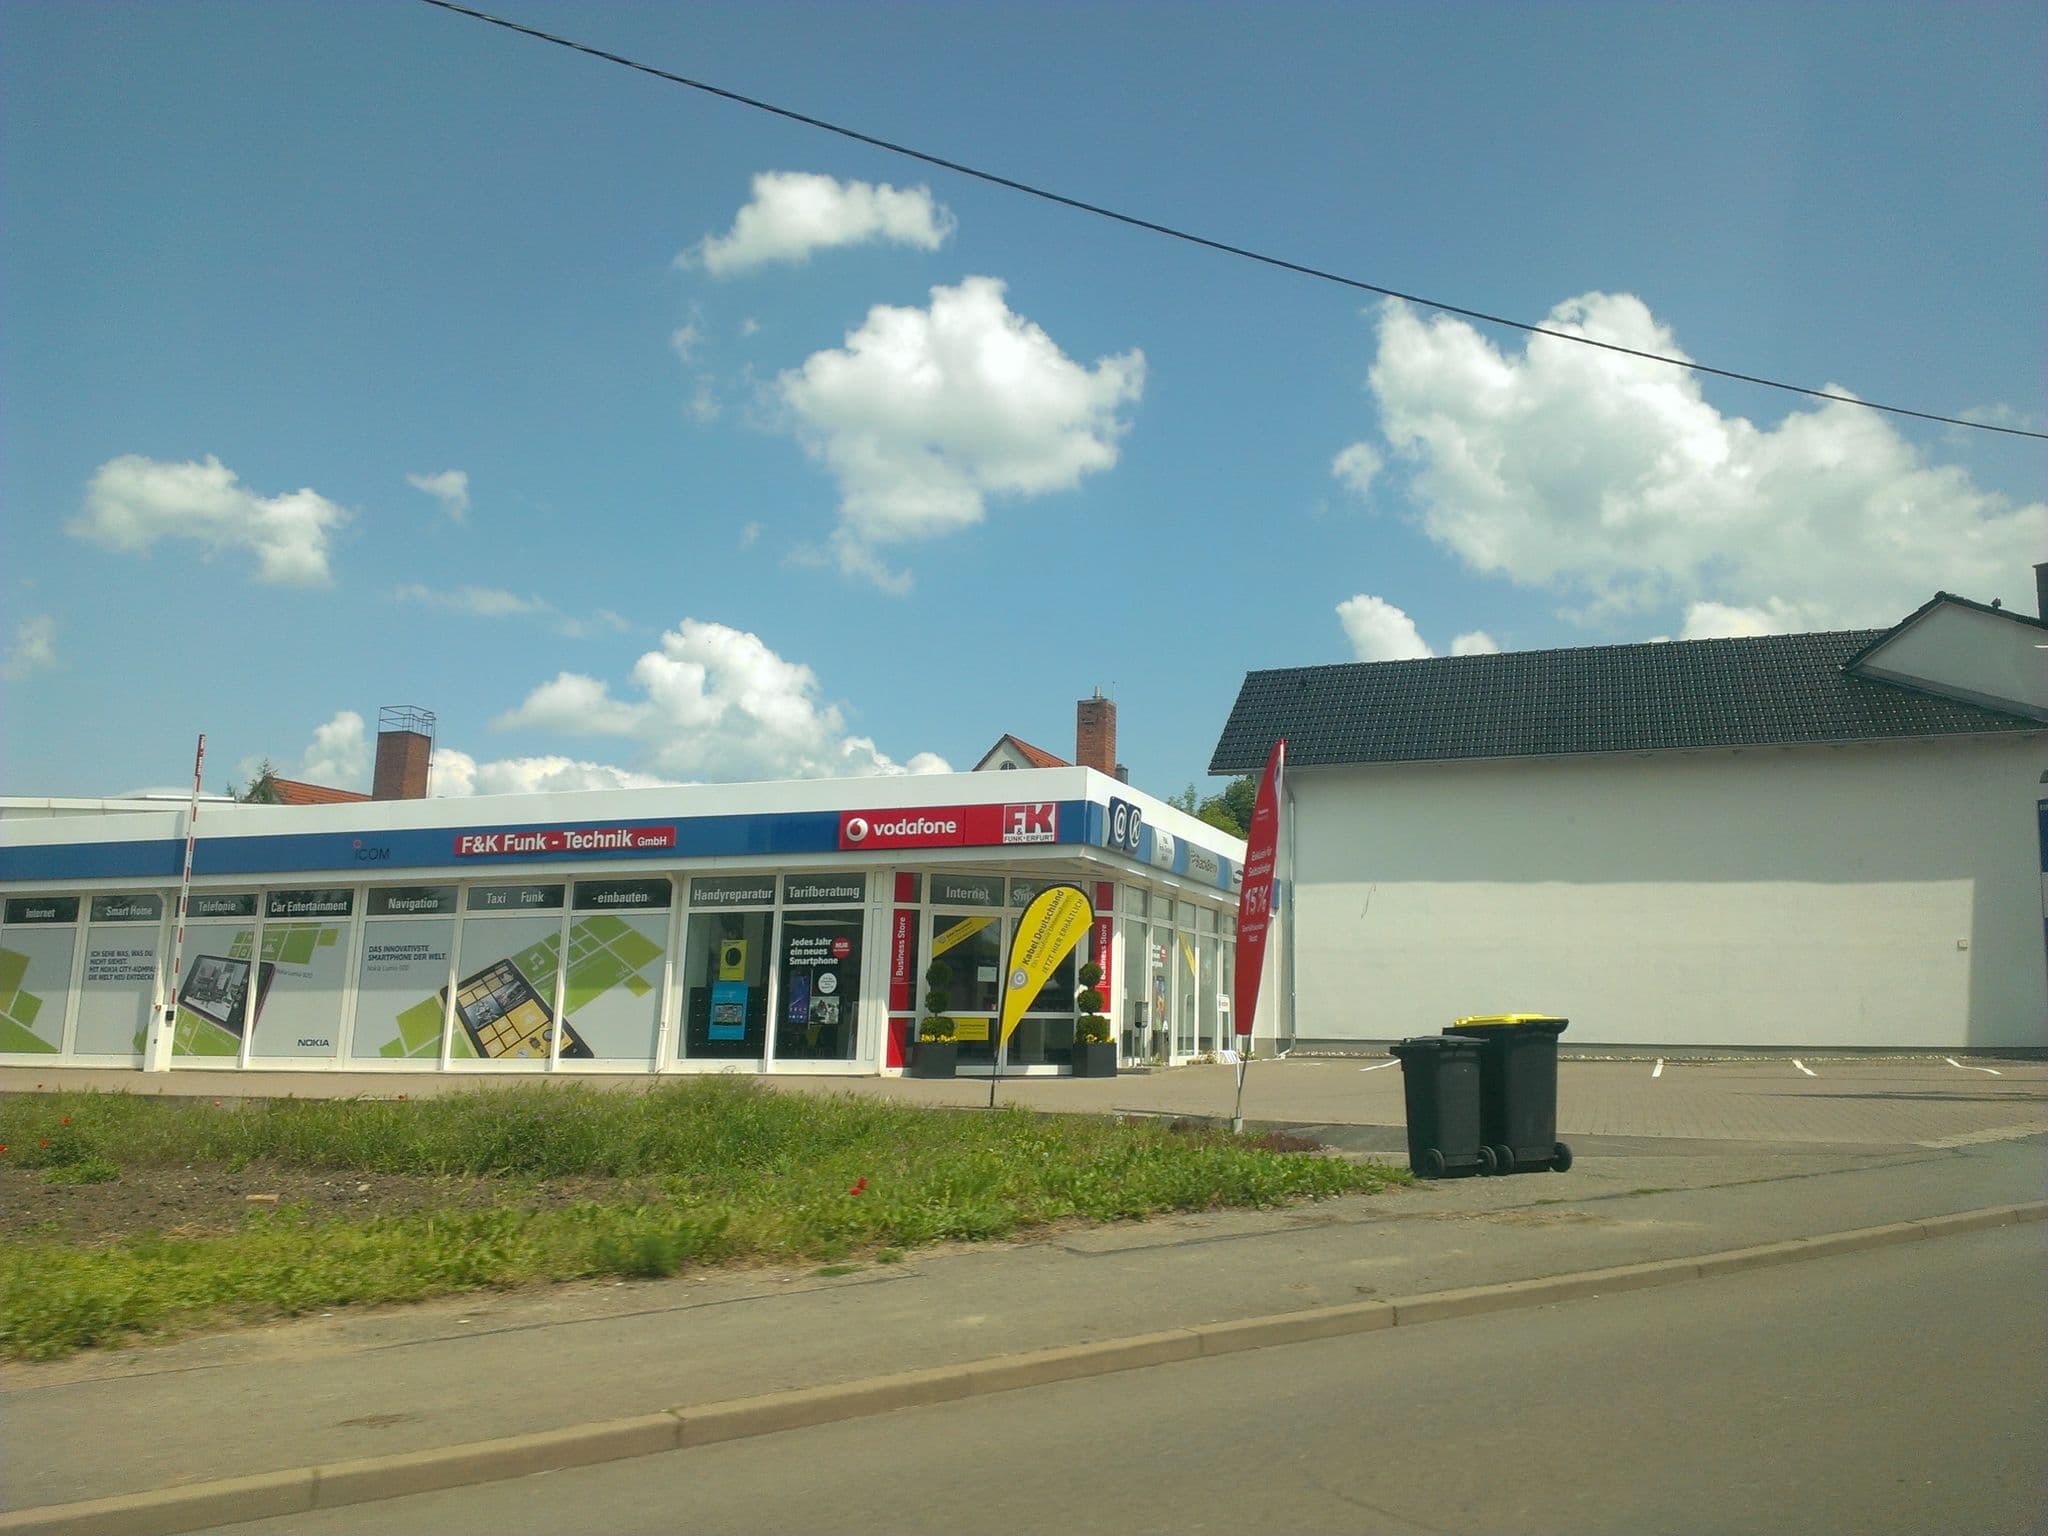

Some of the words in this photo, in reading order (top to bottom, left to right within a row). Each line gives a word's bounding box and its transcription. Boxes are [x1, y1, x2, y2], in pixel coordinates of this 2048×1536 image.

[873, 818, 957, 836] vodafone
[461, 834, 499, 853] F&K
[503, 833, 547, 851] Funk
[563, 830, 633, 848] Technik
[637, 836, 667, 847] GmbH
[486, 892, 507, 904] Taxi
[520, 891, 544, 903] Funk
[693, 888, 774, 903] Handyreparatur
[788, 886, 860, 899] Tarifberatung
[946, 886, 989, 901] Internet
[199, 901, 236, 911] Telefonie
[271, 902, 286, 912] Car
[287, 900, 348, 912] Entertainment
[388, 897, 439, 910] Navigation
[25, 908, 56, 918] Internet
[106, 905, 129, 916] Smart
[130, 905, 153, 915] Home
[897, 916, 906, 938] Store
[1022, 941, 1040, 965] Kabel
[1032, 889, 1066, 940] Deutschland
[791, 938, 813, 947] Jedes
[815, 937, 832, 946] Jahr
[790, 947, 802, 955] ein
[895, 939, 905, 976] Business
[1042, 954, 1055, 974] JETZT
[1051, 938, 1062, 954] HIER
[789, 957, 838, 966] Smartphone
